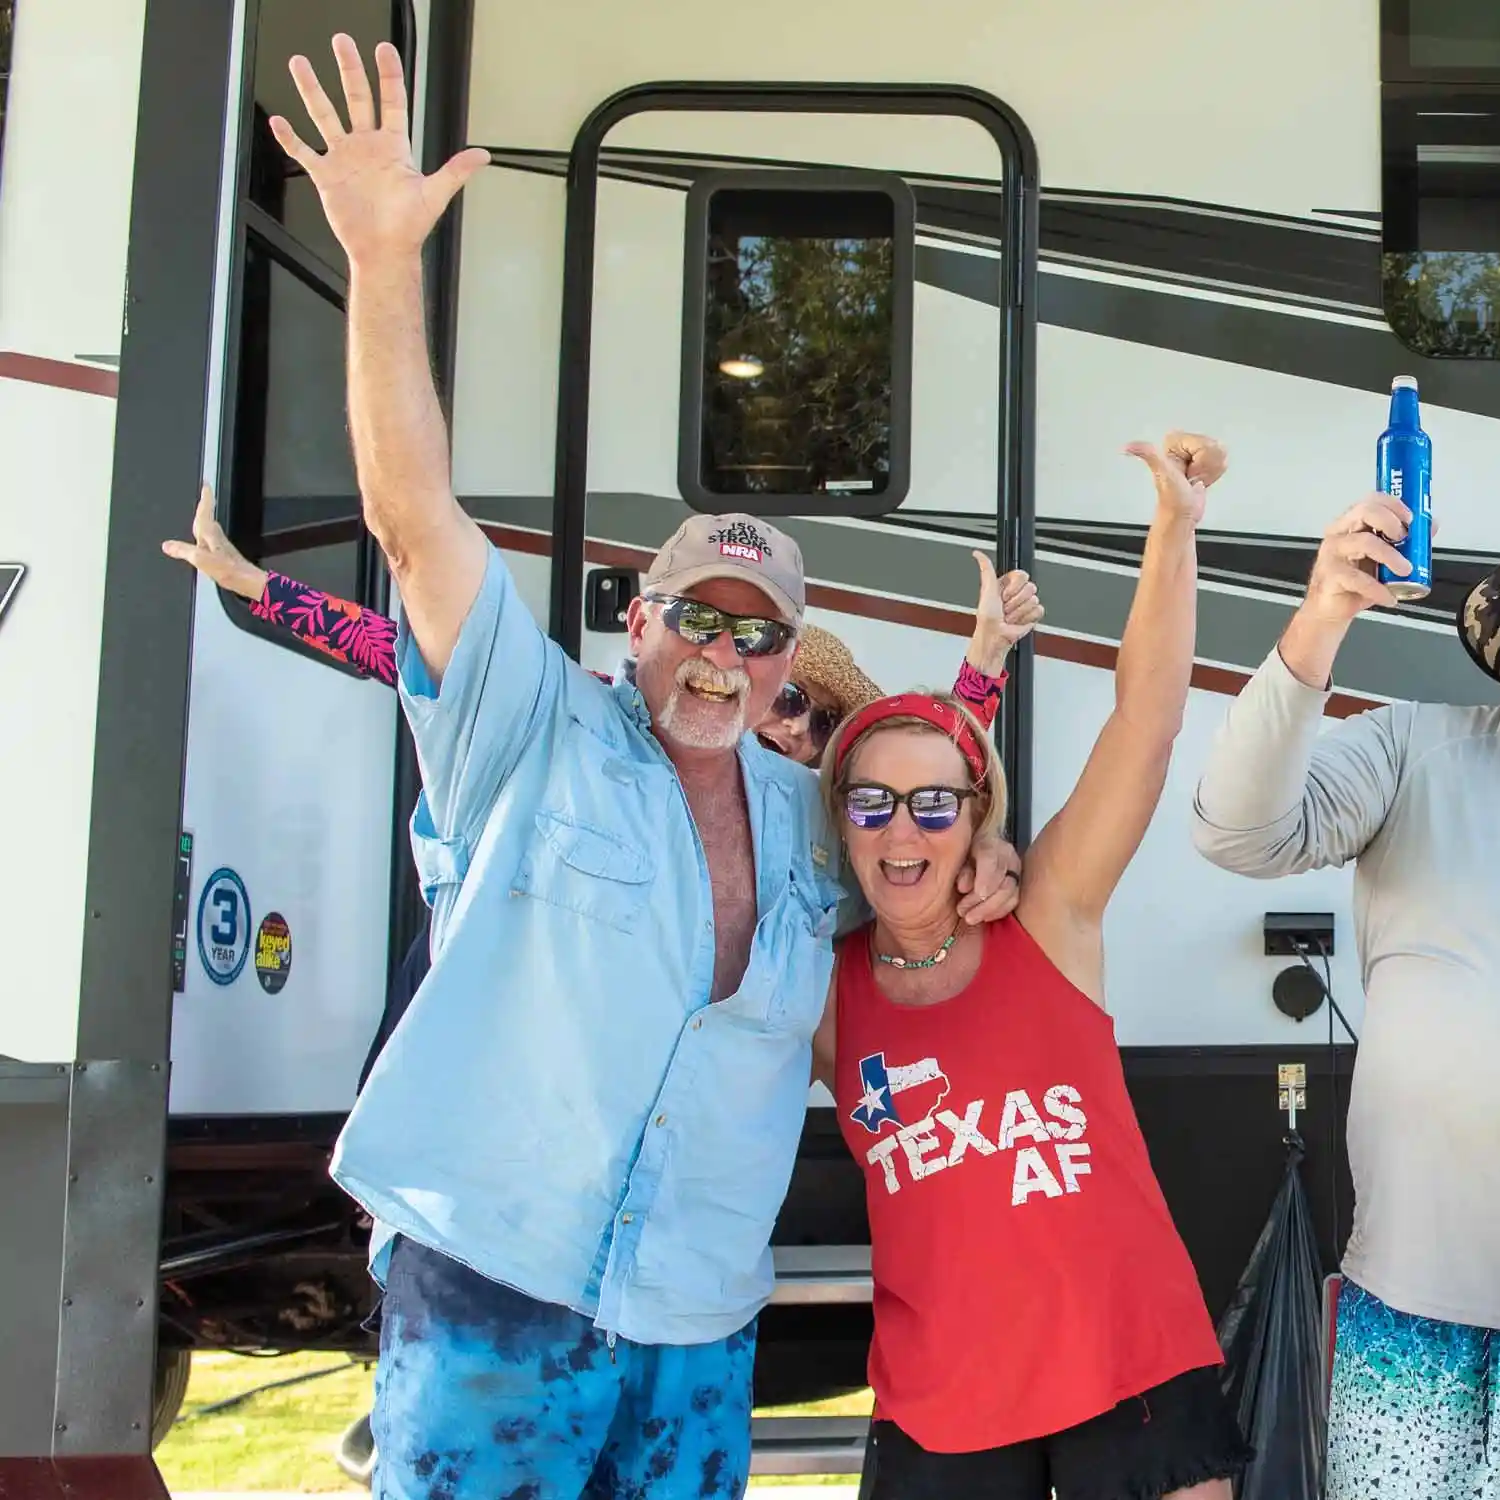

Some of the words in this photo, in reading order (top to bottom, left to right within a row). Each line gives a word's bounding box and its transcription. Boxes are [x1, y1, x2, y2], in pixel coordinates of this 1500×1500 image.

[708, 535, 772, 556] STRONG
[716, 529, 768, 545] YEARS
[722, 545, 759, 560] NRA
[211, 888, 237, 946] 3
[259, 929, 290, 953] keyed
[211, 947, 236, 962] YEAR
[256, 951, 281, 970] alike
[866, 1084, 1088, 1195] TEXAS
[1011, 1142, 1092, 1206] AF
